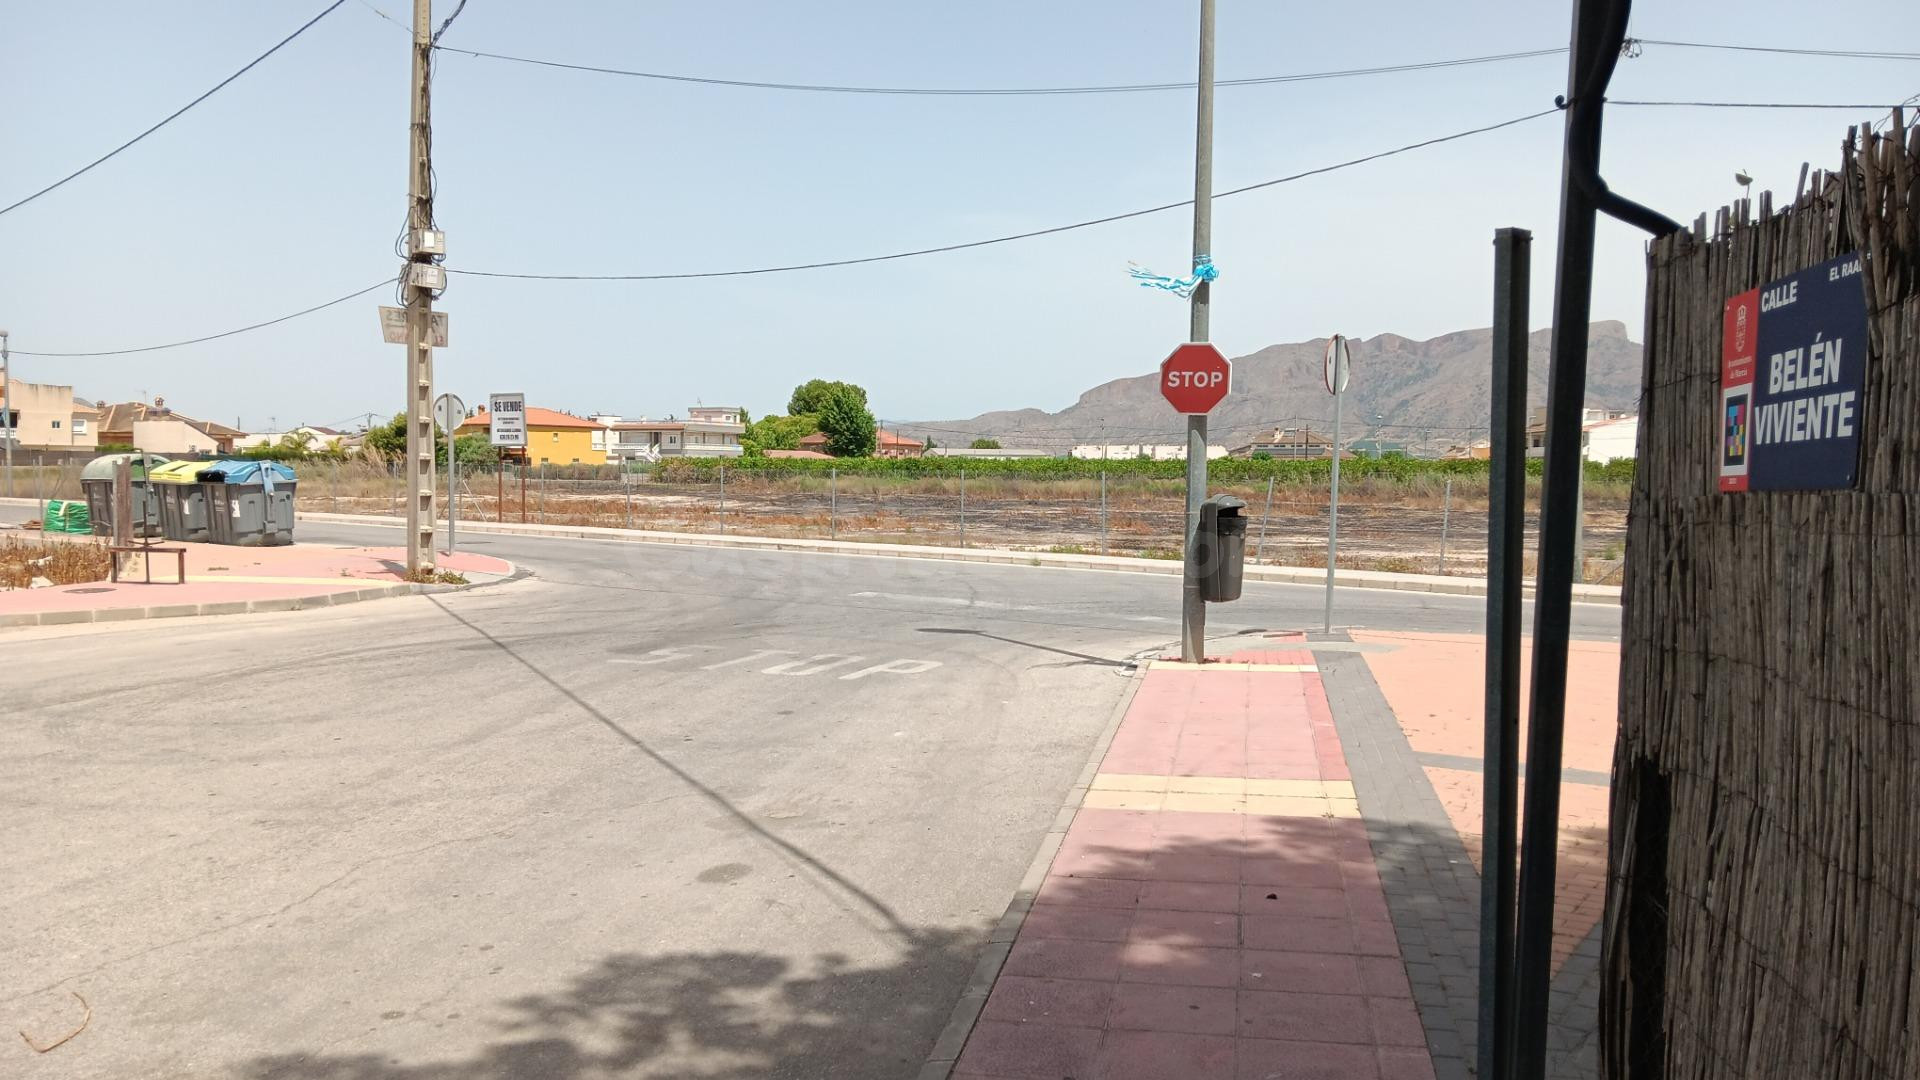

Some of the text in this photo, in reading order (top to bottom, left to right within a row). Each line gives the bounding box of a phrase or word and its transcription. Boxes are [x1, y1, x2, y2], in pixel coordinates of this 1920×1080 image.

[1829, 266, 1840, 281] EL
[1761, 280, 1798, 313] CALLE
[1768, 332, 1842, 395] BELÉN
[1167, 371, 1224, 388] STOP
[494, 401, 522, 412] SE VENDE
[1754, 391, 1855, 445] VIVIENTE
